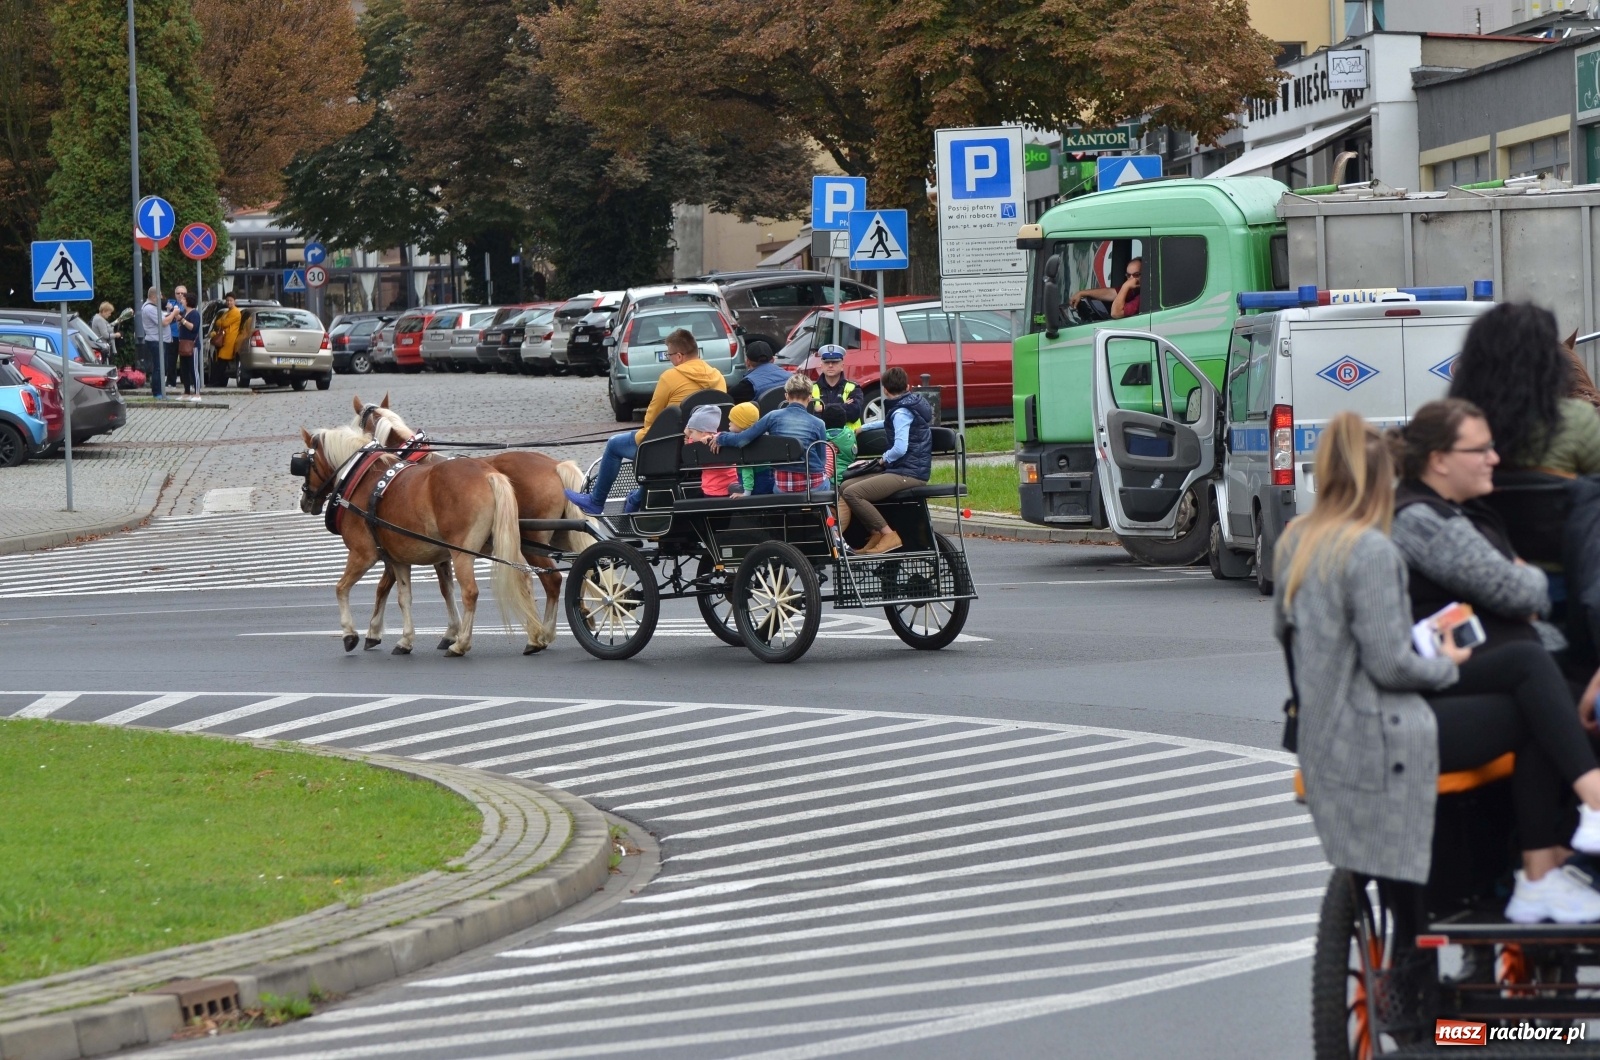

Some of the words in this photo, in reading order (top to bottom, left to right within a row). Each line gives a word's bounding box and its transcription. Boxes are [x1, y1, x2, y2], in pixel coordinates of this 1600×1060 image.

[1066, 132, 1127, 147] KANTOR
[964, 145, 998, 192] P
[824, 182, 855, 224] P
[308, 271, 325, 282] 30
[1343, 367, 1353, 379] R
